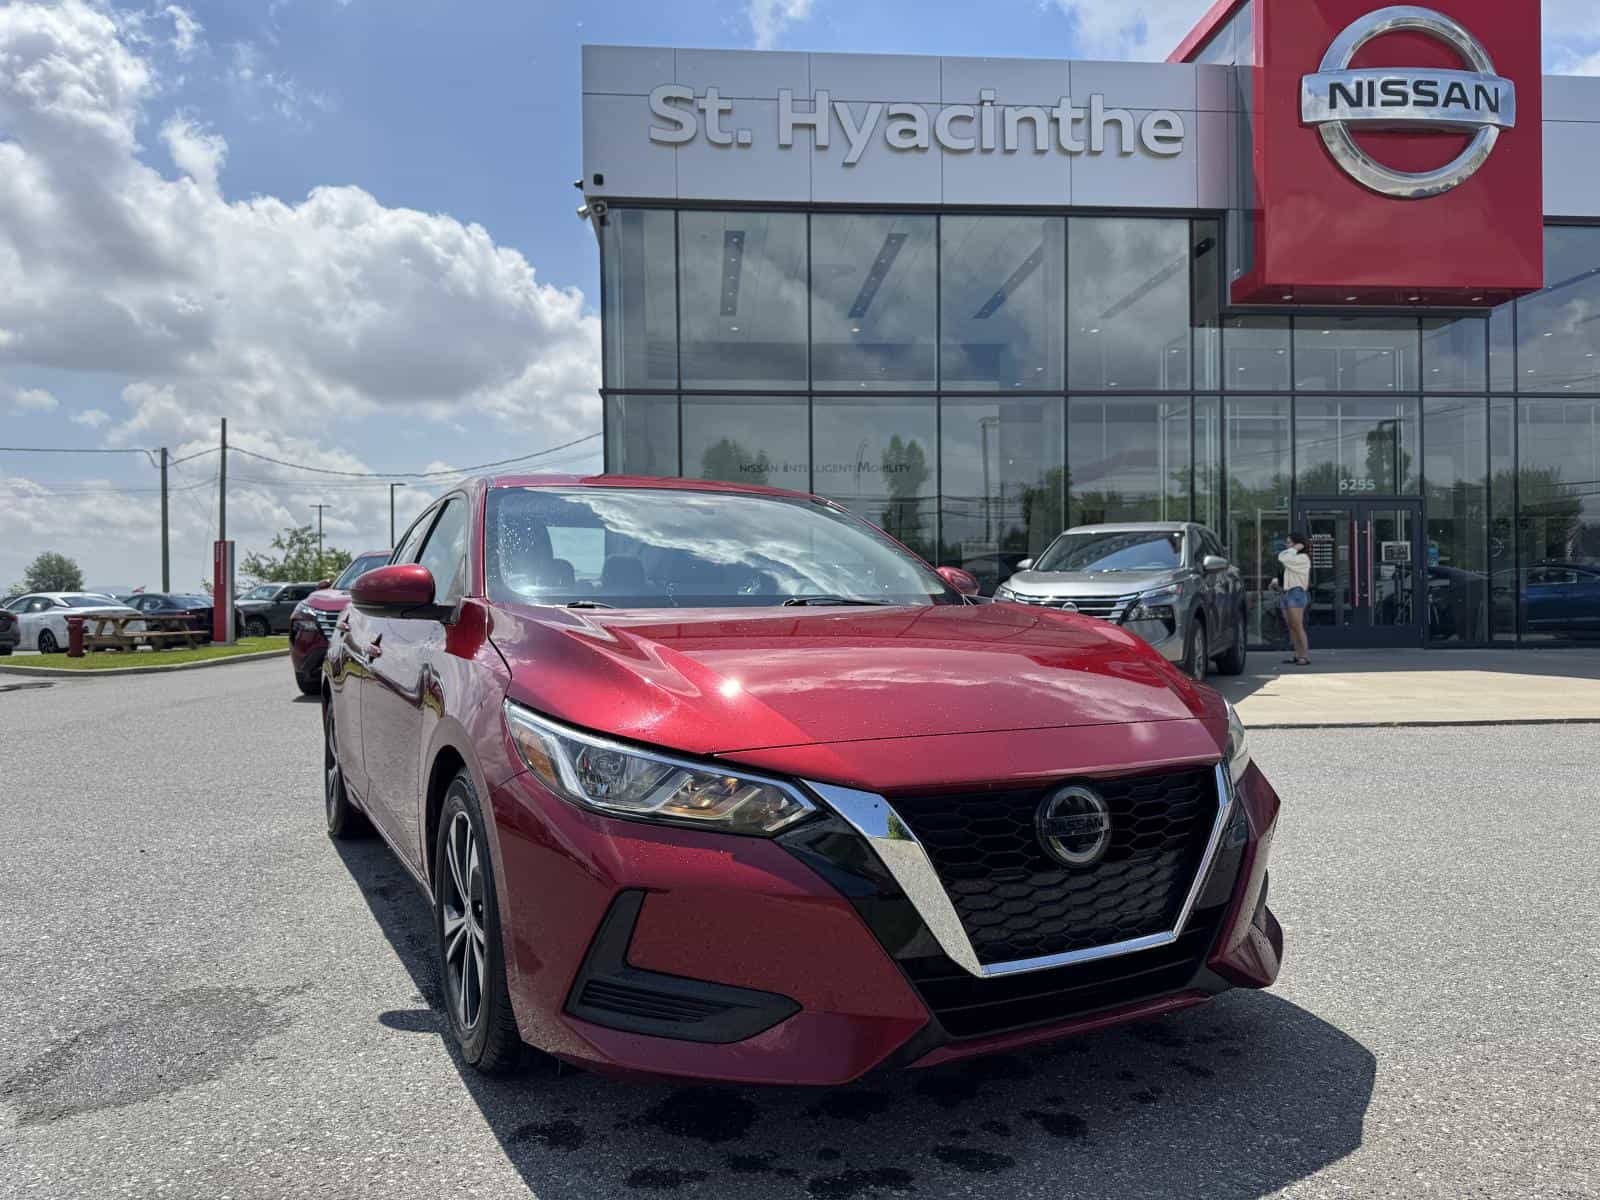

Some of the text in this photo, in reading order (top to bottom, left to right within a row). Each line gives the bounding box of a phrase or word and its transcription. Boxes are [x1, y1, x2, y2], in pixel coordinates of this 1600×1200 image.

[1328, 79, 1499, 113] NISSAN
[648, 84, 1186, 166] St. Hyacinthe
[739, 463, 778, 473] NISSAN
[1338, 479, 1376, 490] 6255
